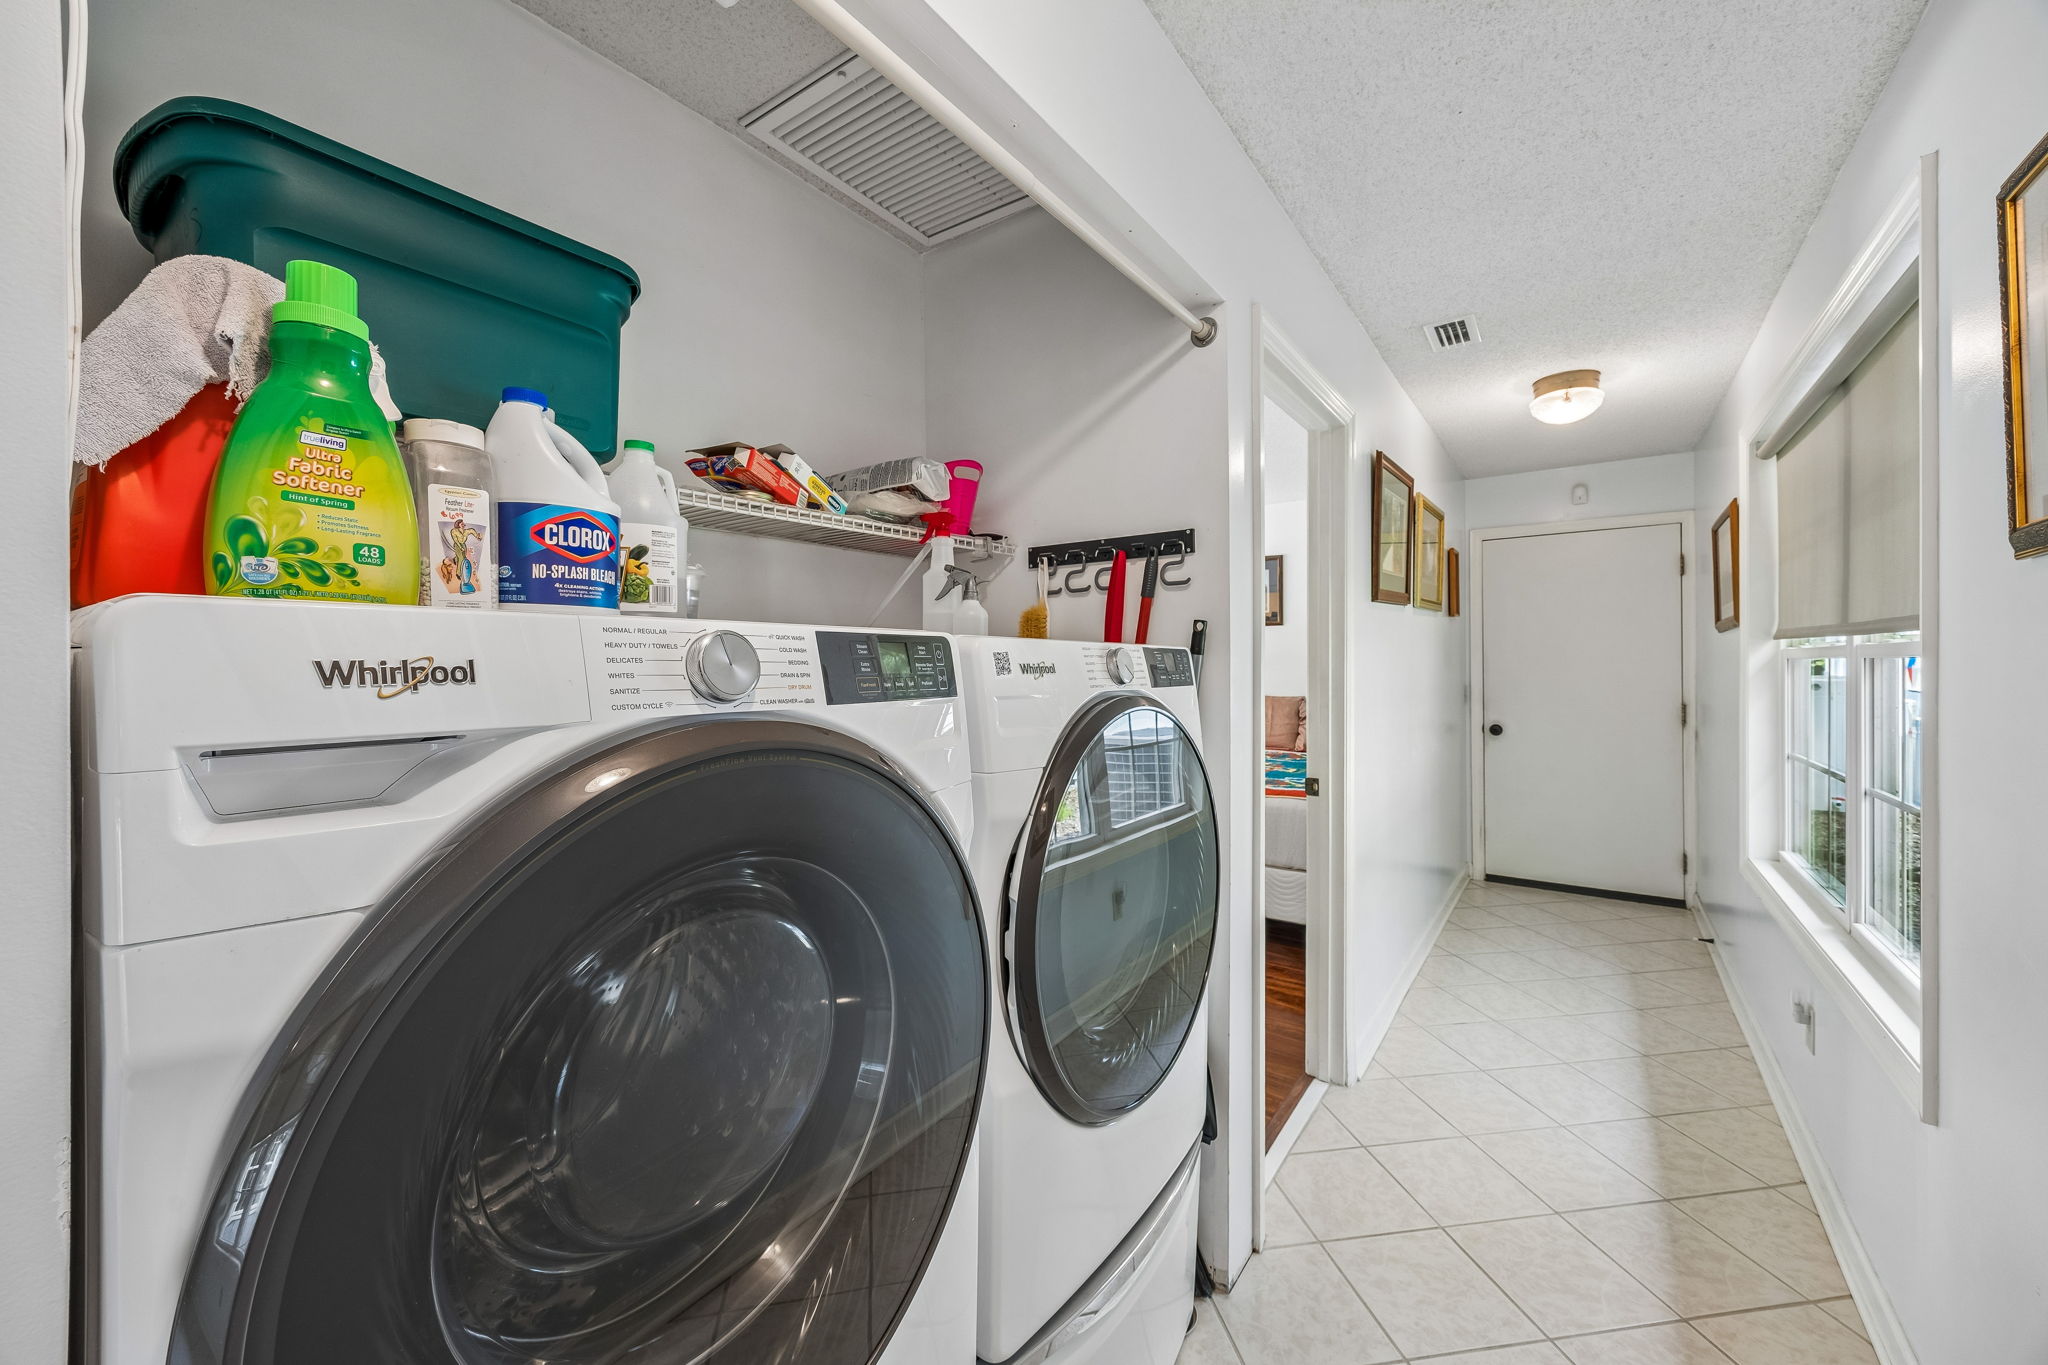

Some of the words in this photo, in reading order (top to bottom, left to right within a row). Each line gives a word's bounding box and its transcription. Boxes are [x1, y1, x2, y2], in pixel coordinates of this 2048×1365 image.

[303, 433, 344, 448] trueliving
[305, 447, 342, 463] Ultra
[289, 457, 353, 481] Fabric
[272, 470, 365, 498] Softener
[289, 493, 307, 502] Hint
[309, 496, 319, 504] of
[320, 498, 348, 509] Spring
[444, 498, 464, 506] Feather
[544, 523, 610, 551] CLOROX
[358, 556, 381, 564] LOADS
[359, 546, 380, 558] 48
[532, 563, 589, 580] NO-SPLASH
[590, 568, 616, 586] BLEACH
[313, 657, 476, 697] Whirlpool
[1019, 662, 1056, 679] Whirlpool
